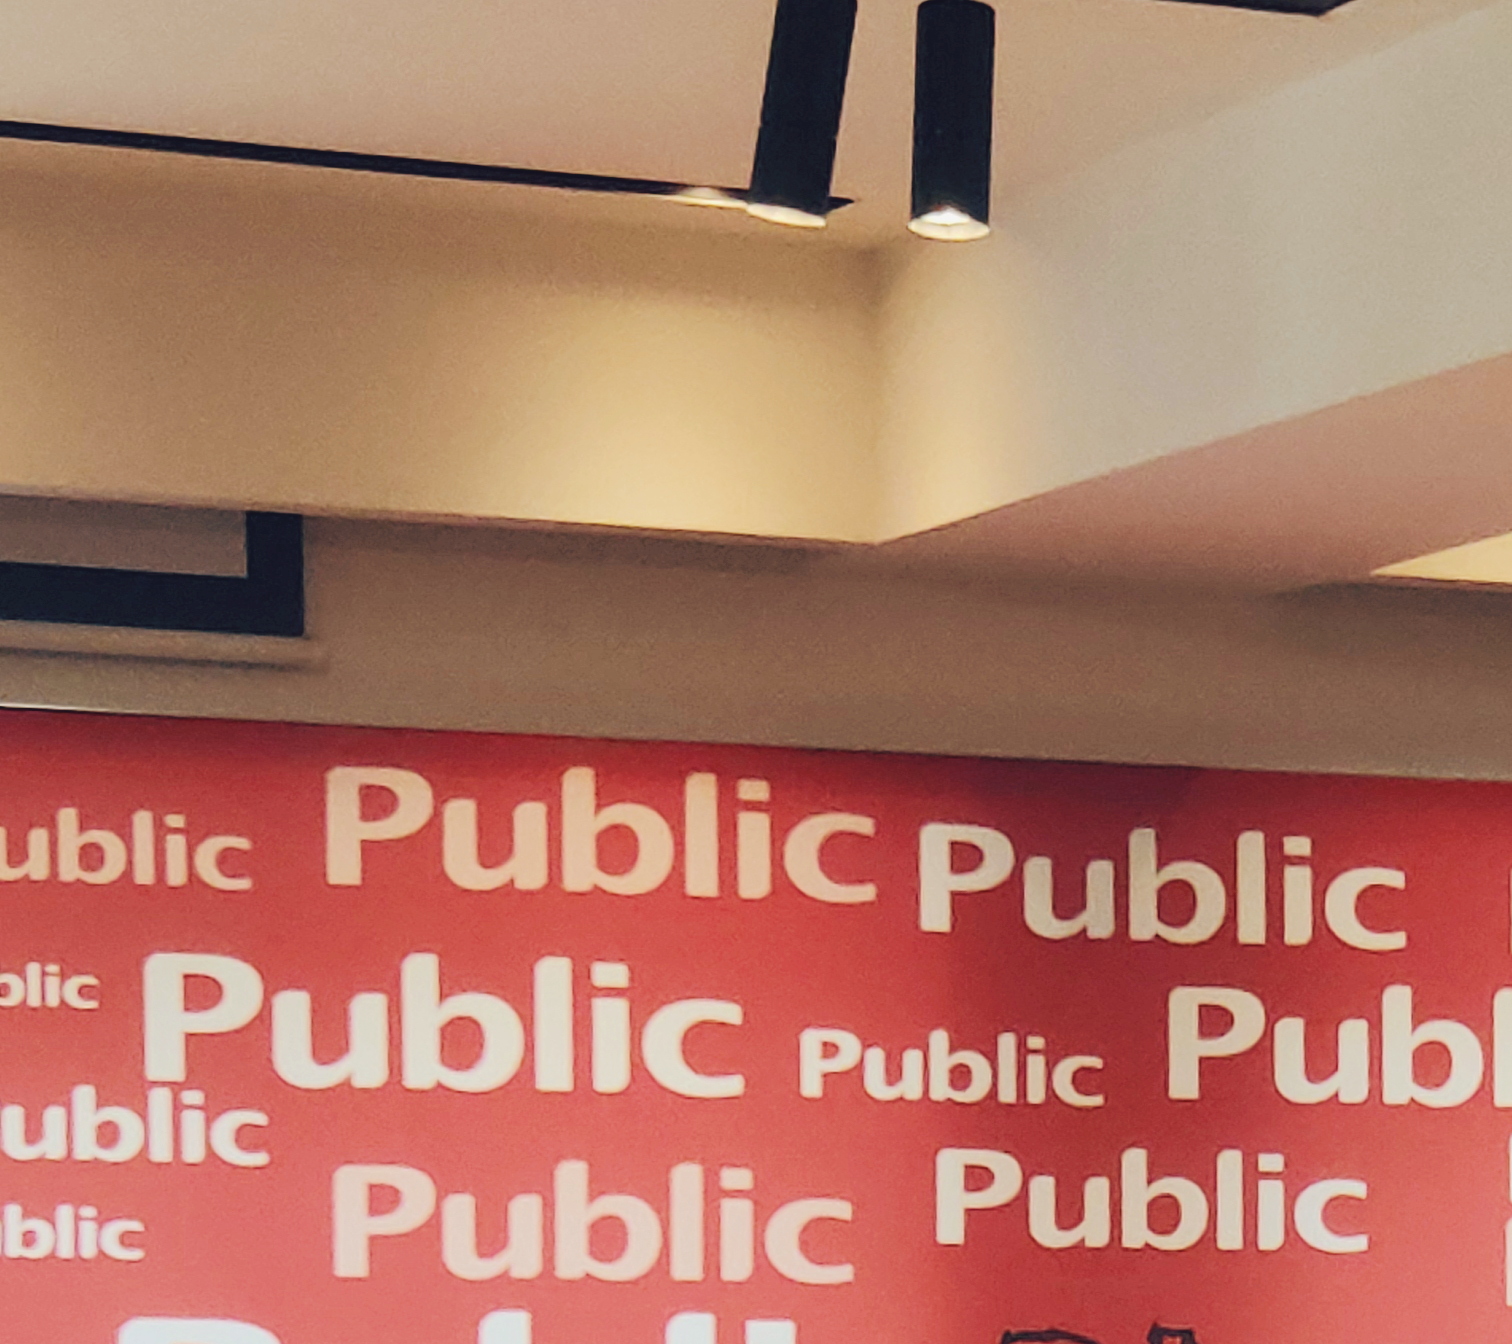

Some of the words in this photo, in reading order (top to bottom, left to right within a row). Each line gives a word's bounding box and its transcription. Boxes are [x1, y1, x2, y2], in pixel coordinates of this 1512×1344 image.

[0, 807, 252, 891] ublic
[325, 766, 877, 903] Public
[918, 822, 1407, 951] Public
[143, 952, 746, 1098] Public
[798, 1027, 1104, 1107] Public
[0, 1084, 271, 1168] ublic
[0, 1202, 147, 1262] blic
[331, 1158, 855, 1285] Public
[935, 1147, 1369, 1254] Public
